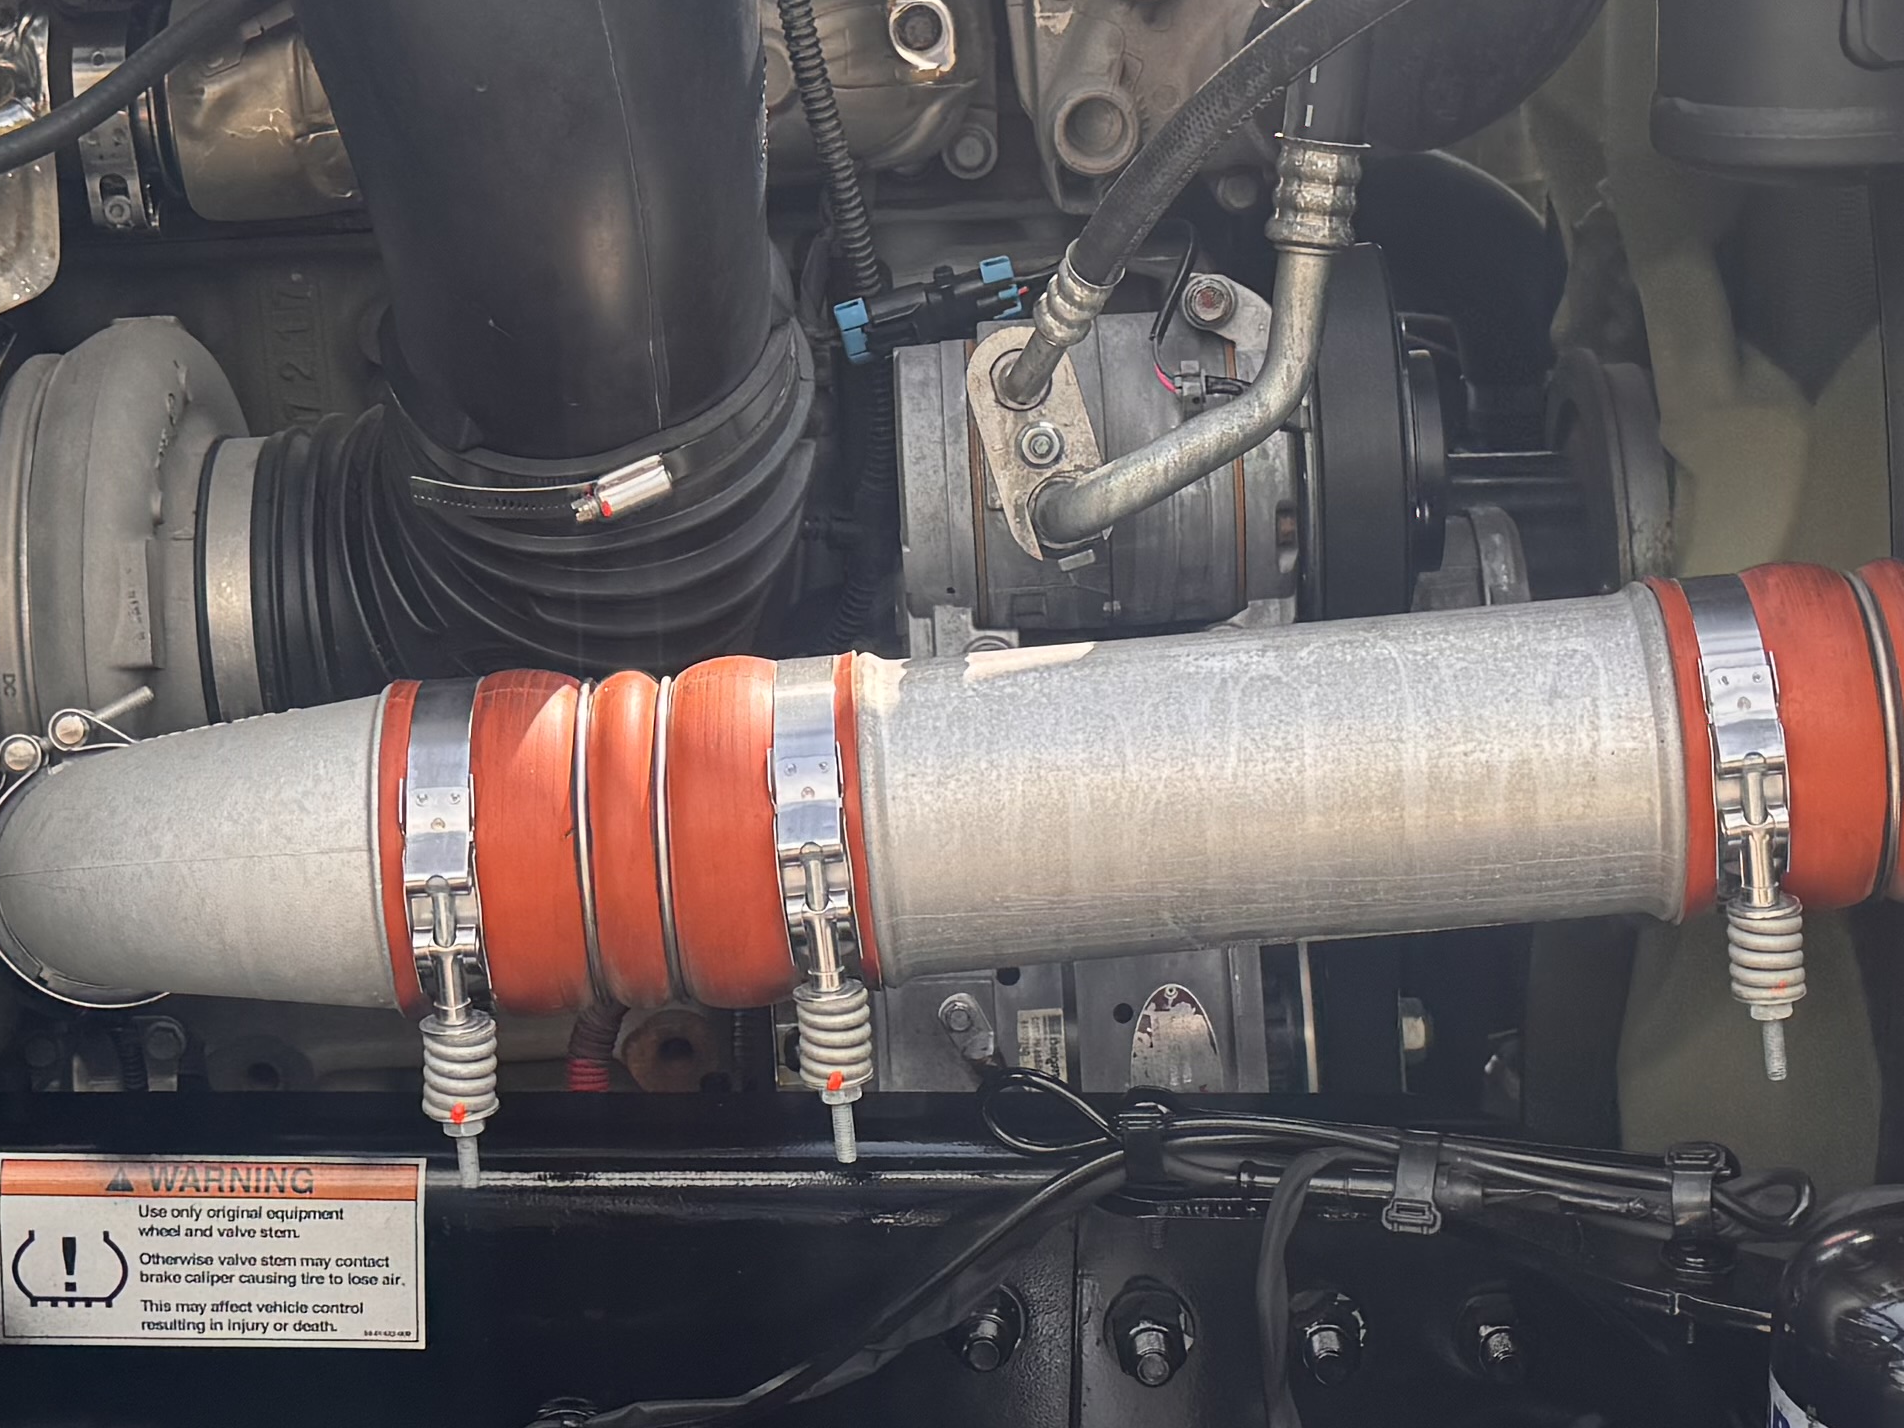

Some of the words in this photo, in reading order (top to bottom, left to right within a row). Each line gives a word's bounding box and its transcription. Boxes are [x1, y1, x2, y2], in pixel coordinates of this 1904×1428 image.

[149, 1164, 314, 1195] WARNING
[138, 1204, 167, 1219] Use
[171, 1205, 203, 1221] only
[206, 1205, 262, 1222] original
[266, 1207, 344, 1223] equipment
[138, 1225, 181, 1237] wheel
[184, 1225, 213, 1238] and
[217, 1225, 256, 1238] valve
[260, 1226, 300, 1239] stem.
[139, 1252, 214, 1267] Otherwise
[218, 1253, 256, 1267] valve
[260, 1255, 297, 1267] stem
[300, 1257, 332, 1270] may
[335, 1254, 389, 1268] contact
[139, 1271, 181, 1284] brake
[184, 1271, 235, 1287] caliper
[238, 1272, 297, 1288] causing
[300, 1273, 325, 1285] tire
[328, 1273, 344, 1286] to
[347, 1273, 378, 1287] lose
[381, 1274, 406, 1287] air.
[140, 1299, 171, 1313] This
[175, 1302, 206, 1315] may
[210, 1300, 253, 1314] affect
[256, 1300, 309, 1314] vehicle
[311, 1301, 364, 1315] control
[141, 1318, 206, 1334] resulting
[209, 1318, 224, 1332] in
[227, 1318, 269, 1335] injury
[273, 1320, 289, 1332] or
[292, 1319, 338, 1333] death.
